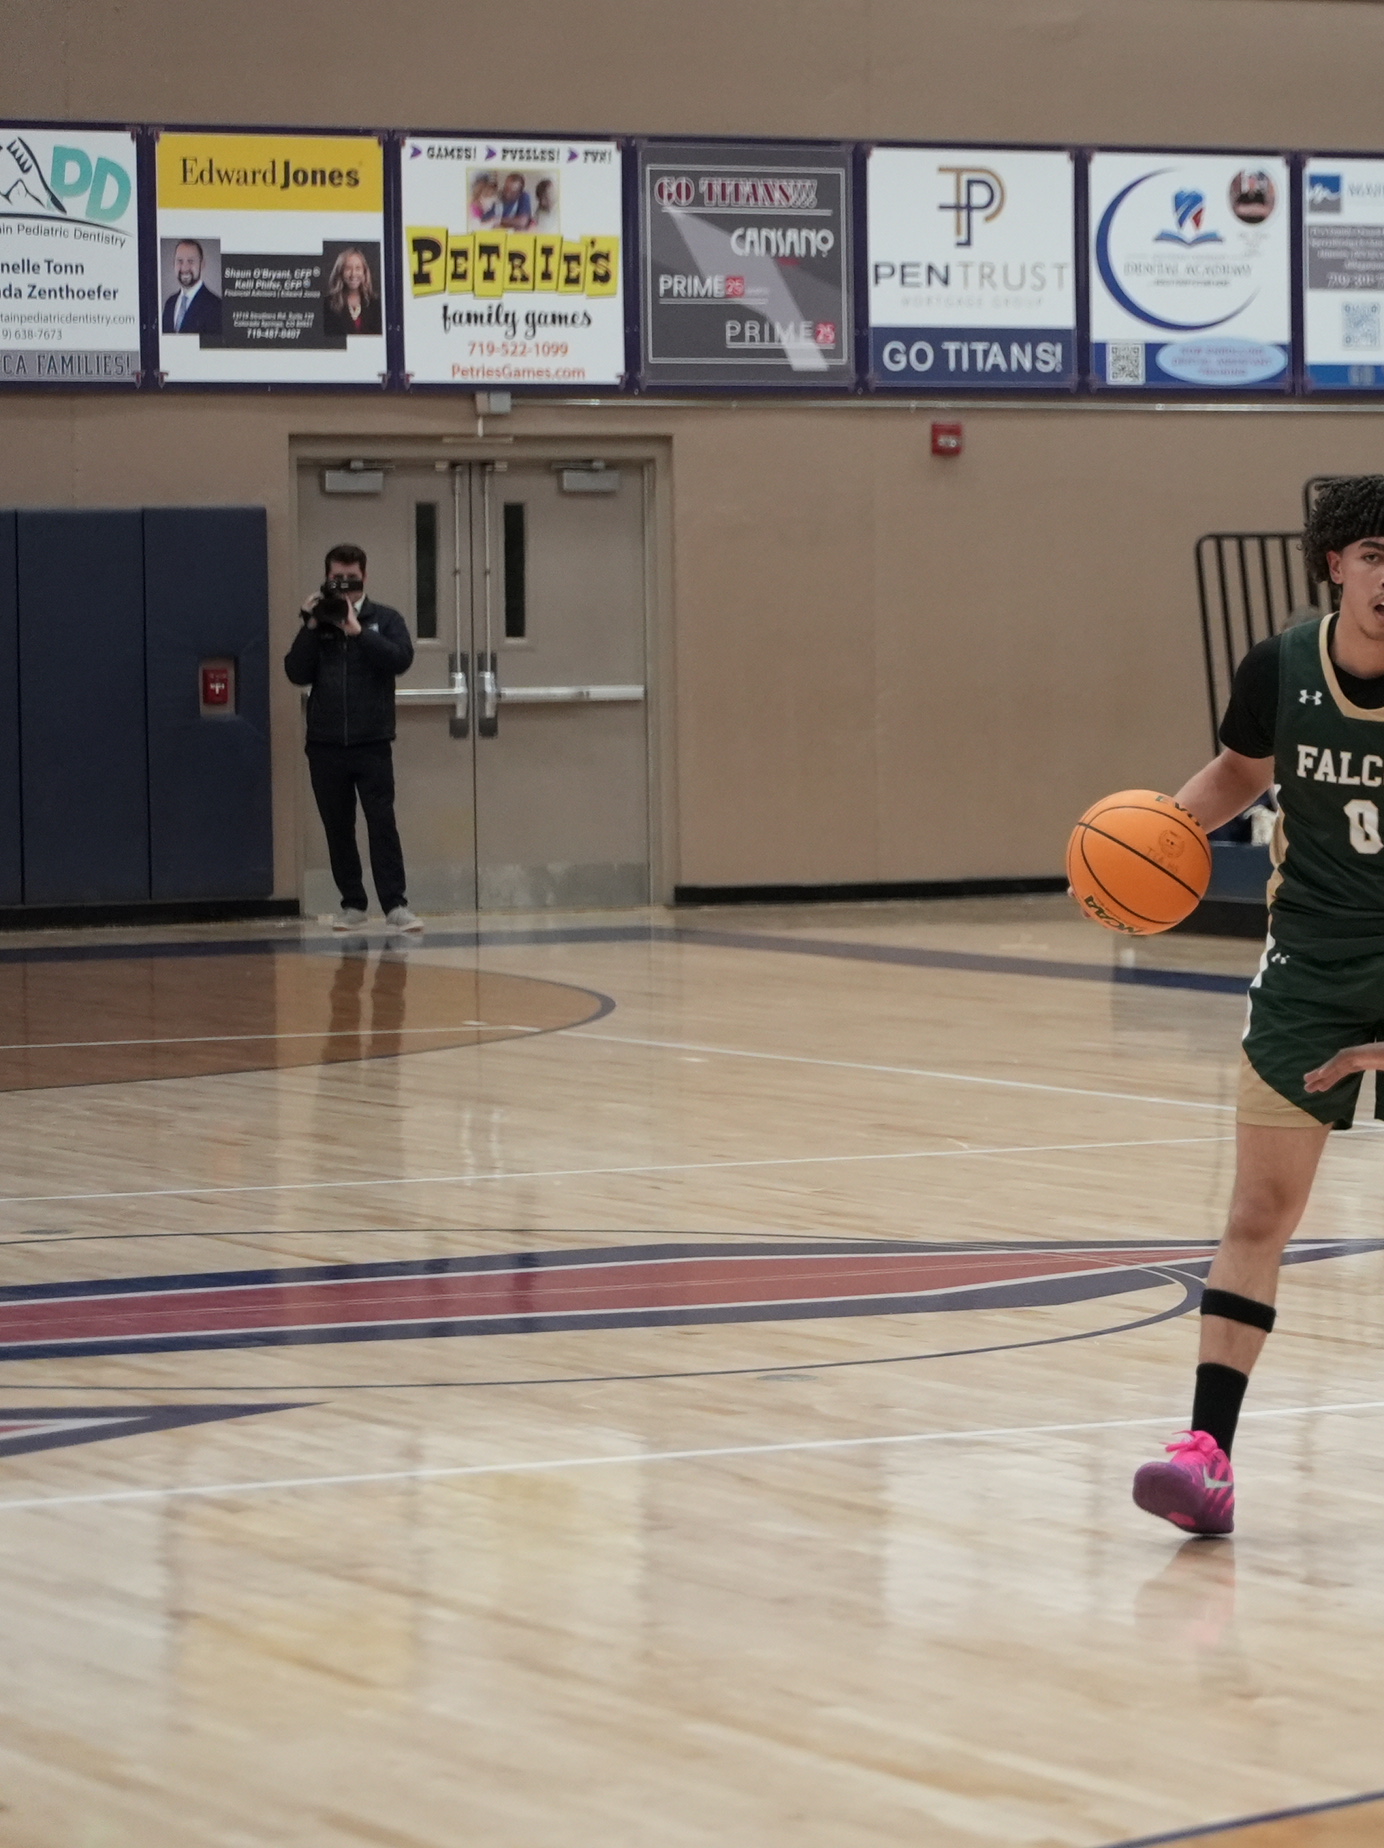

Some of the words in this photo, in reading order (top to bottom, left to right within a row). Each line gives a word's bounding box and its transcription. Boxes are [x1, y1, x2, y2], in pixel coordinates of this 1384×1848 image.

[426, 146, 477, 161] GAMES!
[501, 147, 561, 162] PUZZLES!
[582, 149, 613, 164] FUN!
[179, 156, 278, 187] Edward
[280, 159, 360, 191] Jones
[654, 176, 696, 207] GO
[699, 177, 818, 208] TITANS!!!
[17, 224, 69, 239] Pediatric
[73, 227, 126, 248] Dentistry
[0, 258, 40, 275] nelle
[44, 259, 84, 275] Tonn
[225, 268, 251, 279] Shaun
[0, 283, 22, 299] da
[27, 284, 118, 300] Zenthoefer
[0, 312, 135, 327] tainpediatricdentistry.com
[441, 303, 519, 339] family
[524, 308, 592, 341] games
[14, 329, 62, 340] 638-7673
[467, 341, 570, 357] 719-522-1099
[882, 340, 935, 373] GO
[941, 341, 1063, 373] TITANS!
[3, 354, 27, 375] CA
[37, 354, 130, 375] FAMILIES!
[451, 363, 586, 380] PetriesGames.com
[1343, 798, 1384, 855] 0
